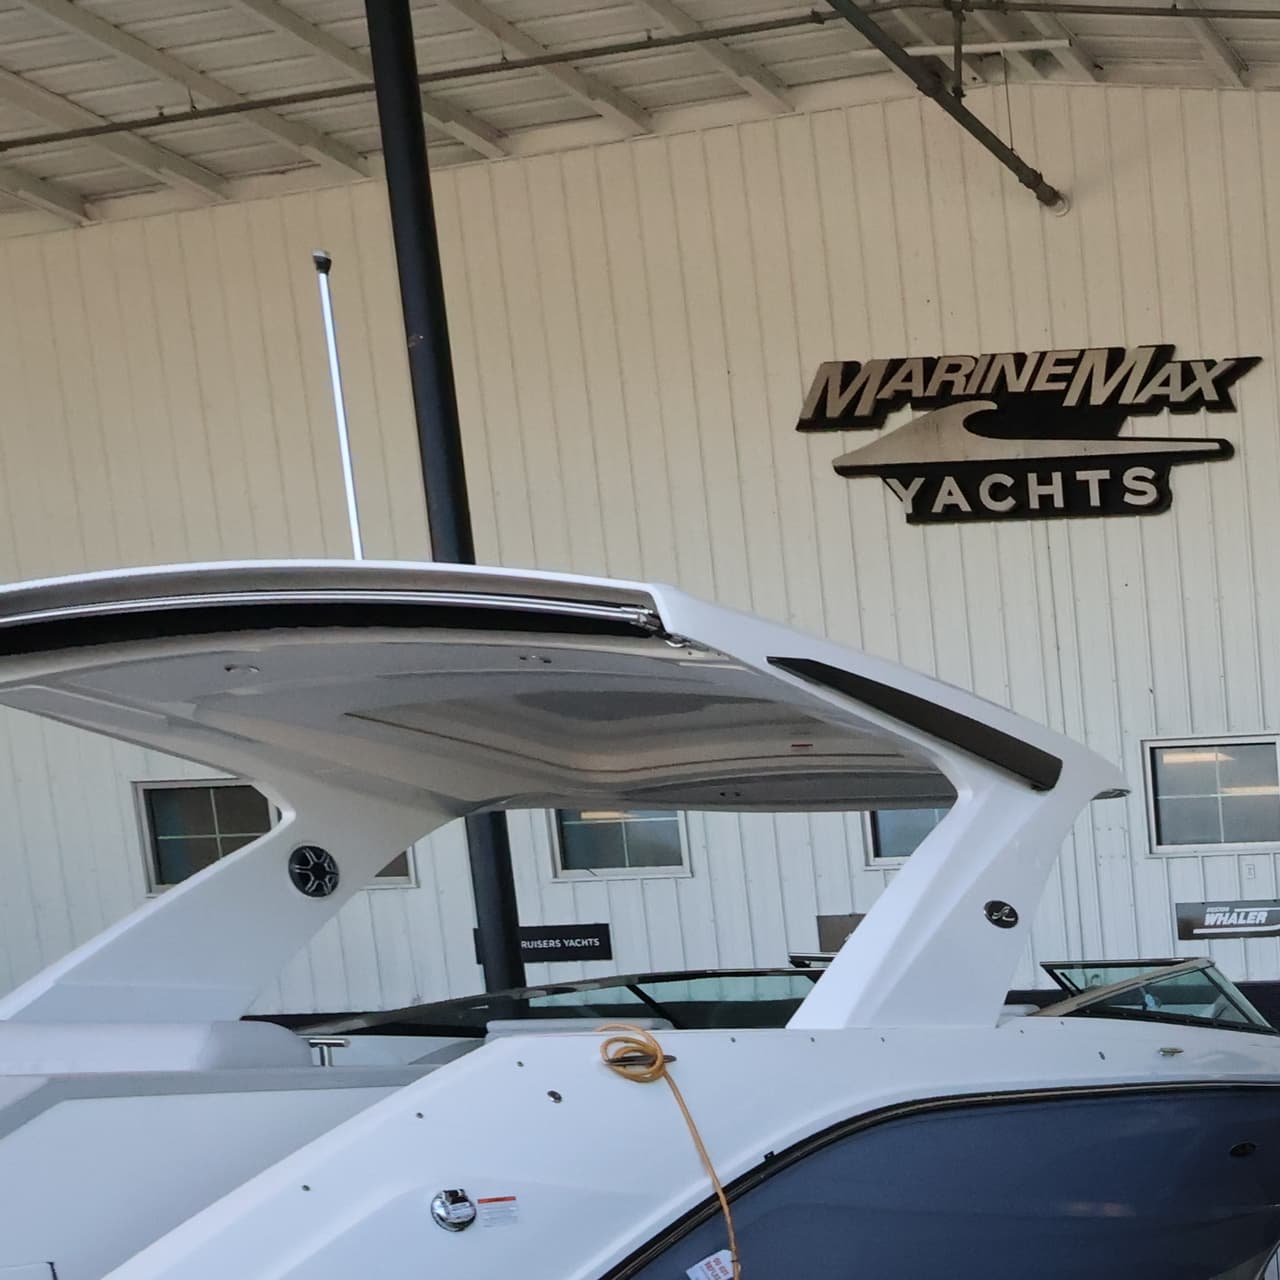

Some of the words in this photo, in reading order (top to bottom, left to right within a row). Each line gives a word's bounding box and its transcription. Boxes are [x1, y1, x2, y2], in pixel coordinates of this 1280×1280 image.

[887, 467, 1159, 514] YACHTS
[1203, 911, 1268, 926] WHALER
[520, 939, 562, 949] RUISERS
[562, 937, 600, 948] YACHTS
